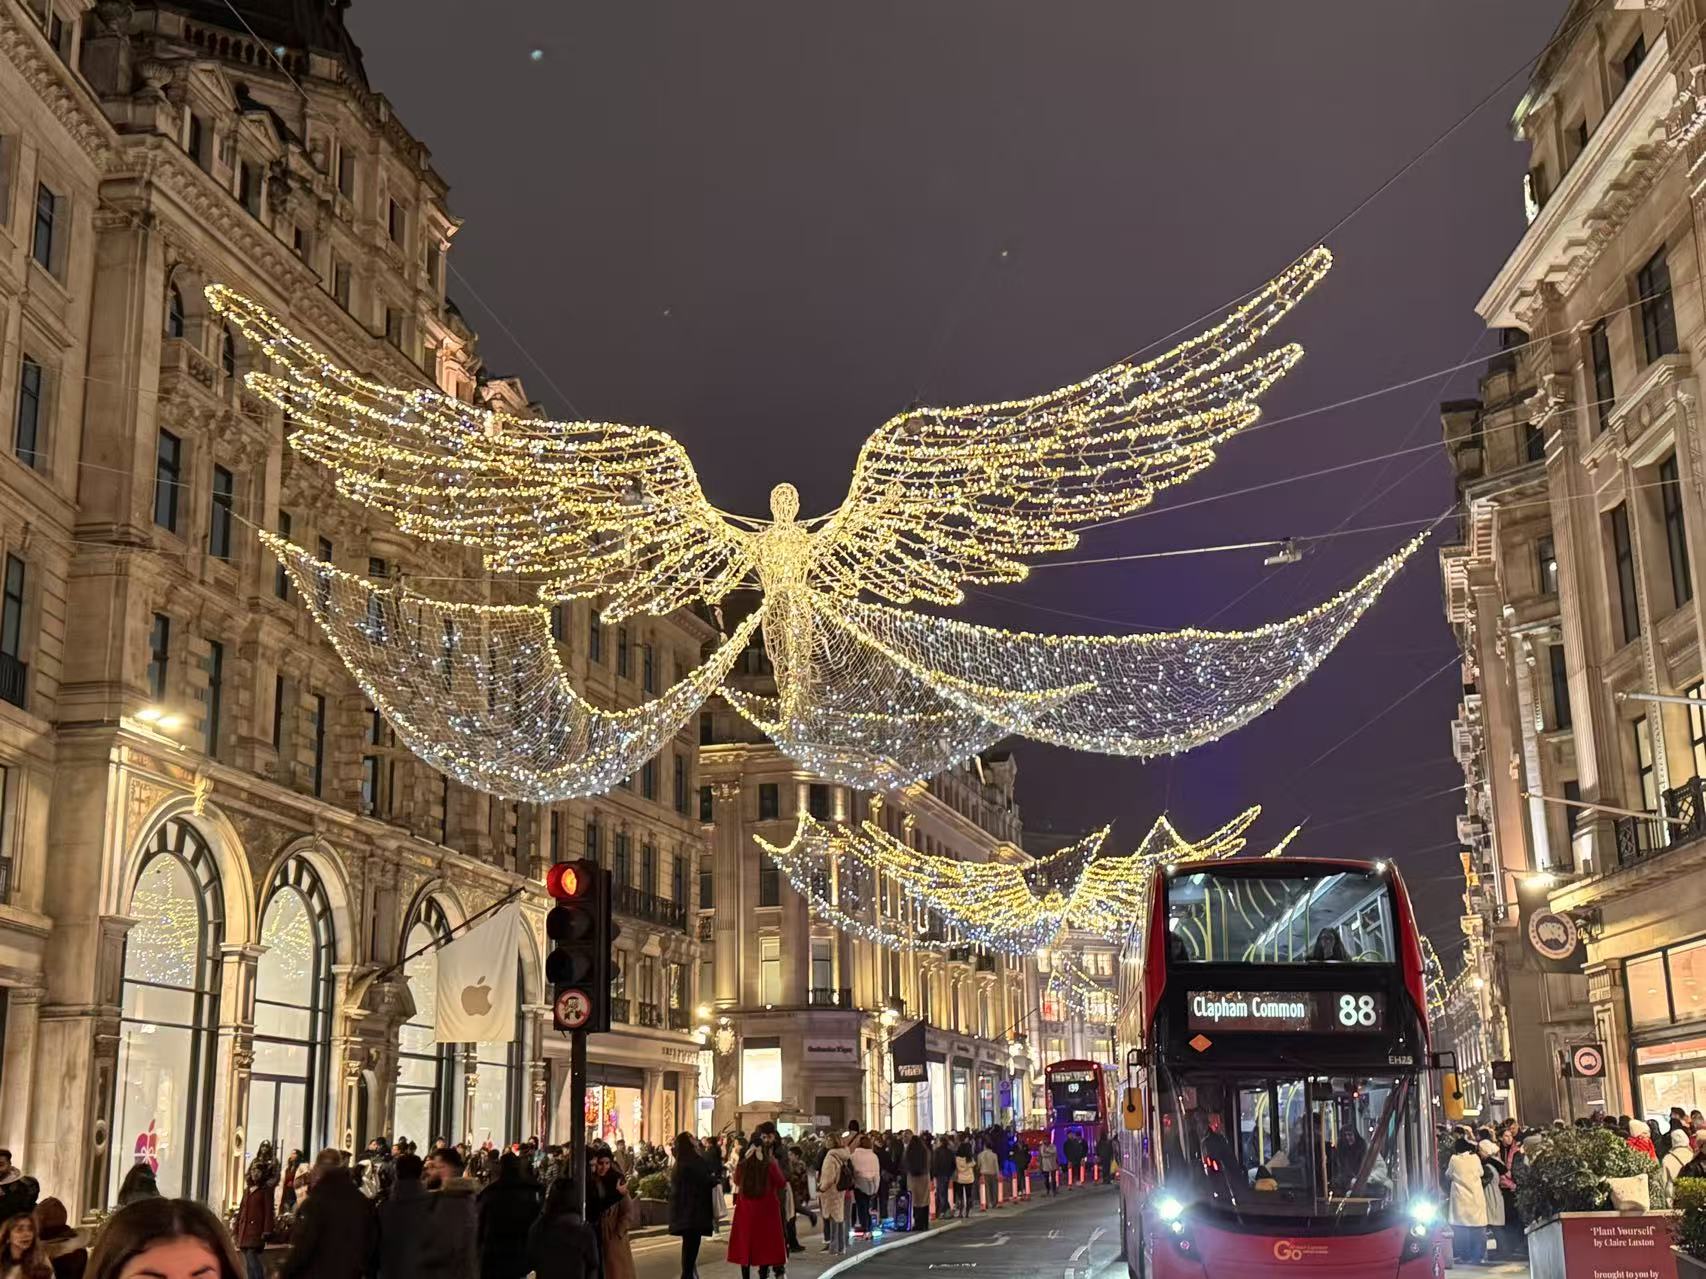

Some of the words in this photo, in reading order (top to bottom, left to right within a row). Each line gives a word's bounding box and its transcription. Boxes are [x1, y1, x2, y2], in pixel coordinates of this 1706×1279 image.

[1193, 996, 1247, 1022] Clapham
[1252, 996, 1305, 1018] Common
[1339, 994, 1376, 1026] 88
[1273, 1240, 1302, 1260] Go
[1594, 1238, 1603, 1248] by
[1604, 1238, 1627, 1247] Claire
[1628, 1238, 1655, 1247] Luxton
[1594, 1270, 1625, 1279] brought
[1626, 1271, 1634, 1279] to
[1649, 1269, 1660, 1279] by
